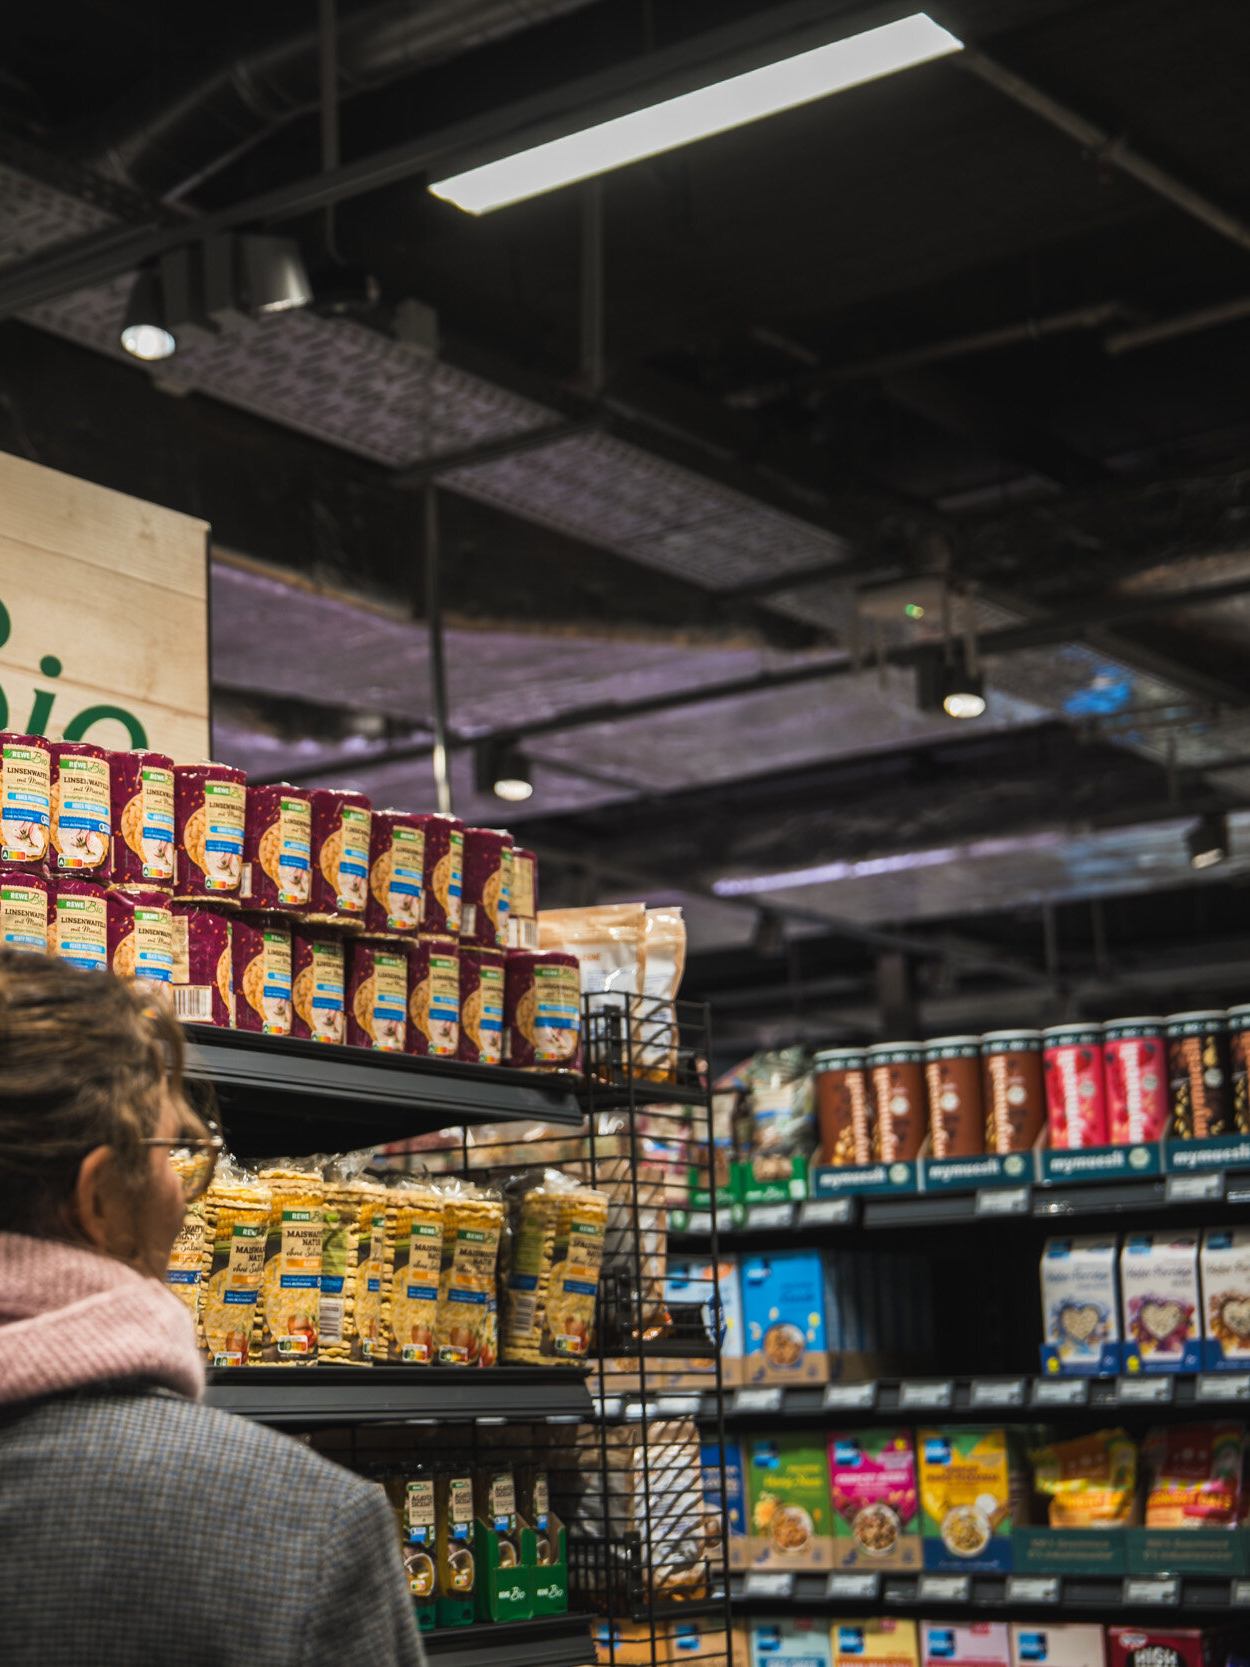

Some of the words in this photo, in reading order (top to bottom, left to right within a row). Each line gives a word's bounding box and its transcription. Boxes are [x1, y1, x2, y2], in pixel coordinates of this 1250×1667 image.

[12, 751, 30, 759] REWE
[69, 761, 87, 769] REWE
[10, 892, 28, 900] REWE
[29, 892, 45, 906] Bio
[85, 901, 104, 913] Bio
